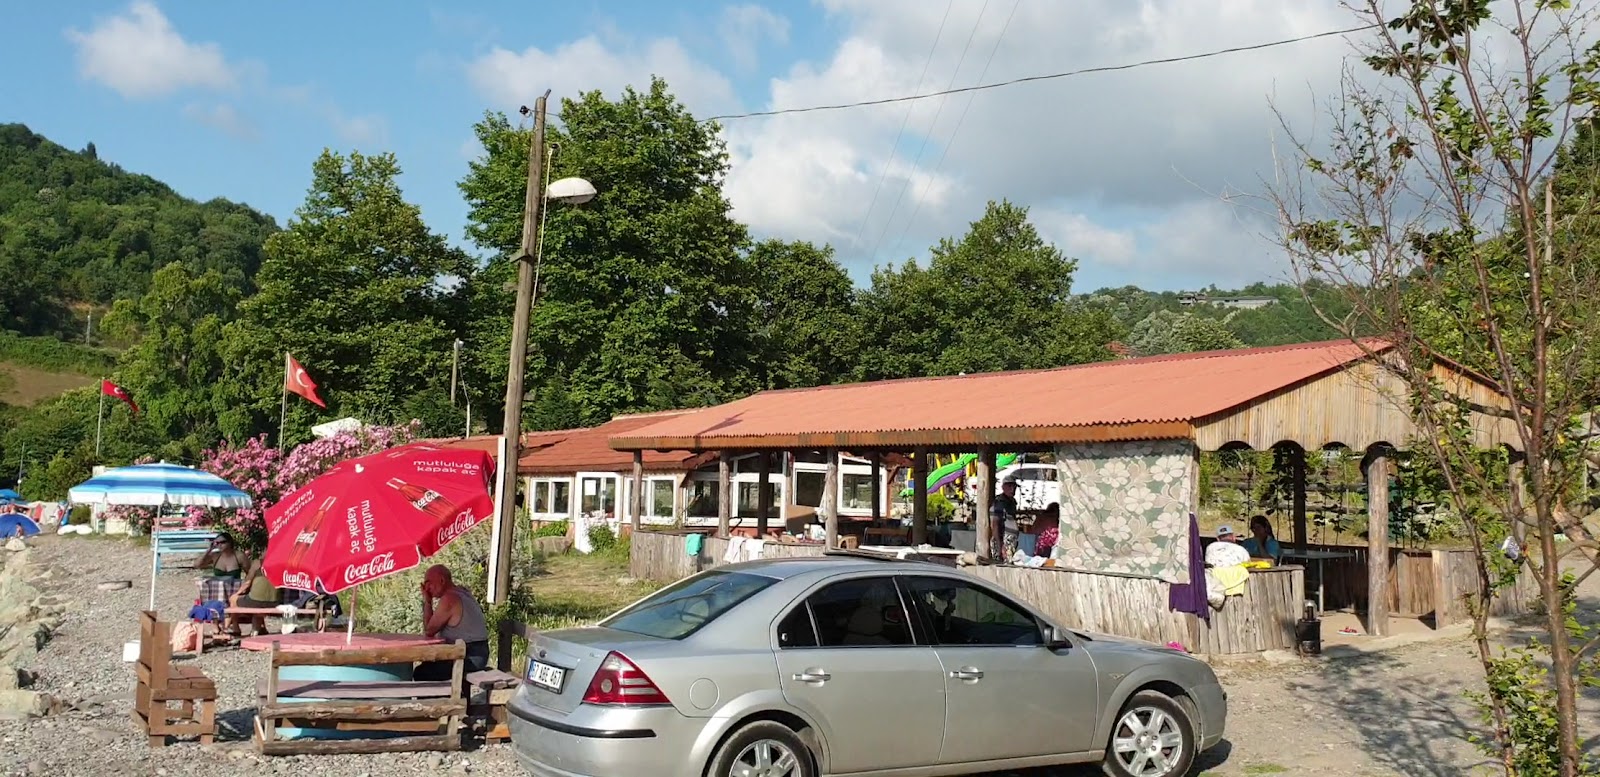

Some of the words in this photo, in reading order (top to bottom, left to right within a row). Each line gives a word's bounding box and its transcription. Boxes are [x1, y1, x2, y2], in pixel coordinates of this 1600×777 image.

[346, 506, 361, 538] kapak
[361, 500, 377, 552] mutluluğa
[349, 540, 360, 554] aç
